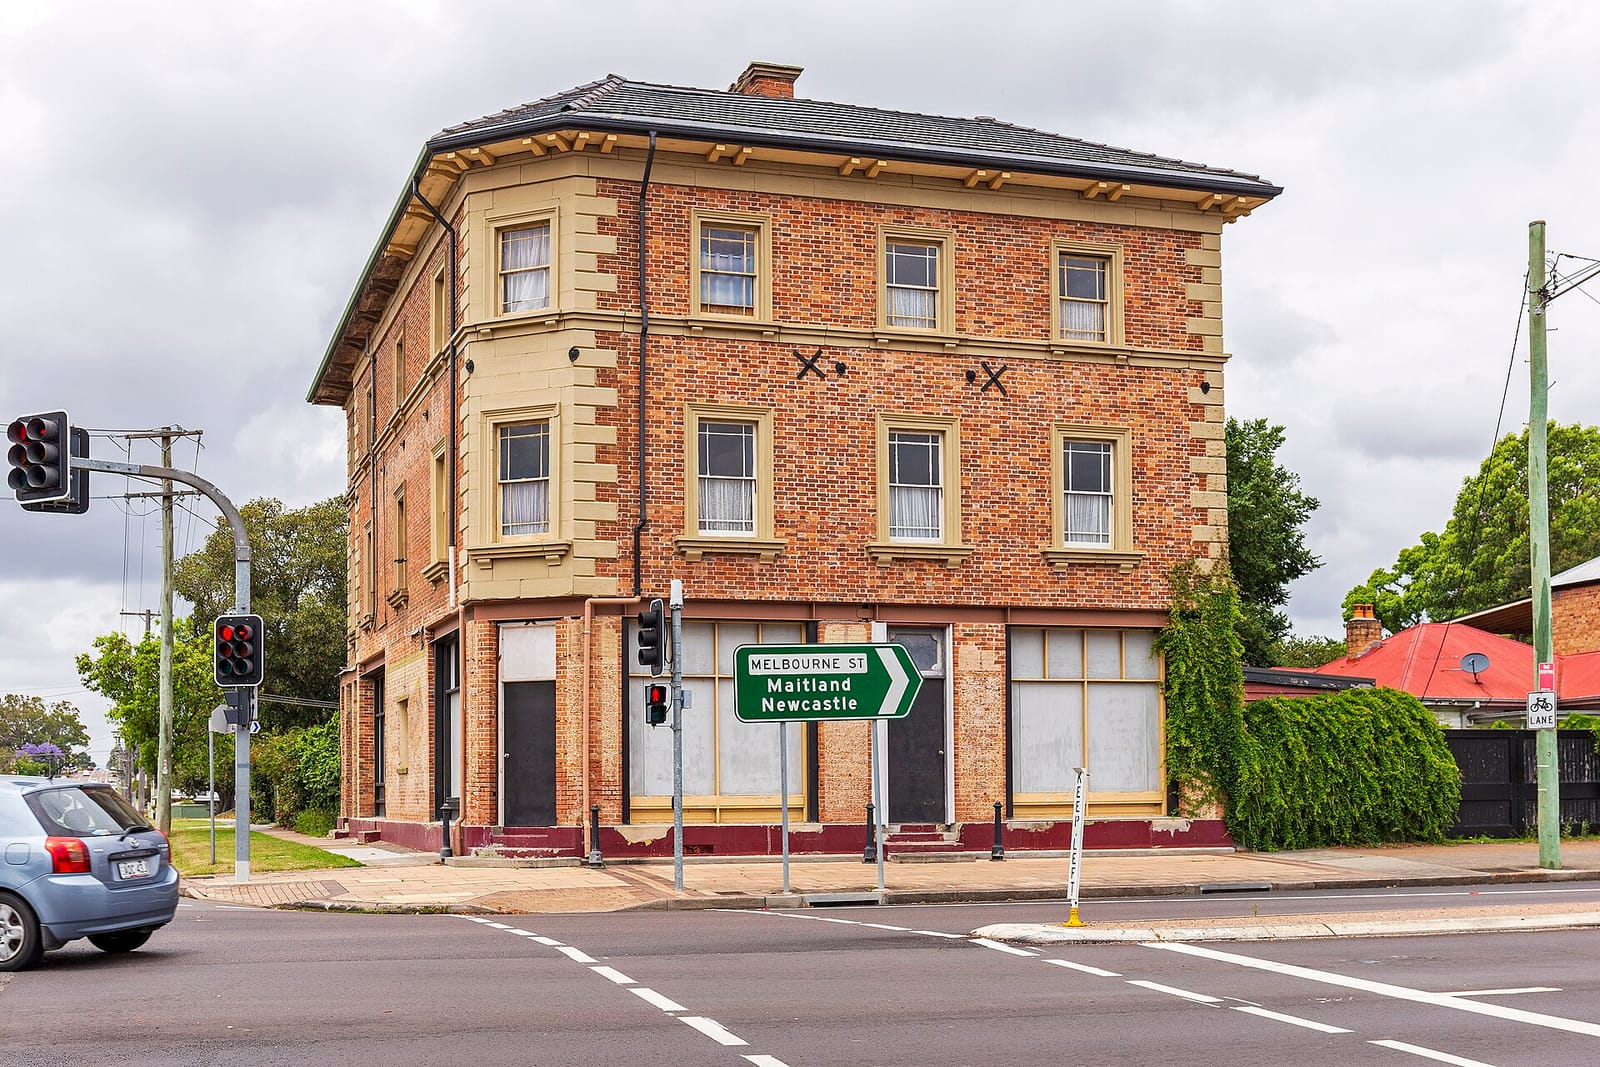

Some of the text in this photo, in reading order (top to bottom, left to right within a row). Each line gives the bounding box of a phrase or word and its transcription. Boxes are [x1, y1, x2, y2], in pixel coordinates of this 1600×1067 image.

[751, 658, 864, 670] MELBOURNE ST
[767, 677, 851, 693] Maitland
[761, 696, 858, 712] Newcastle
[1530, 715, 1553, 725] LANE
[1074, 772, 1082, 827] KEEP
